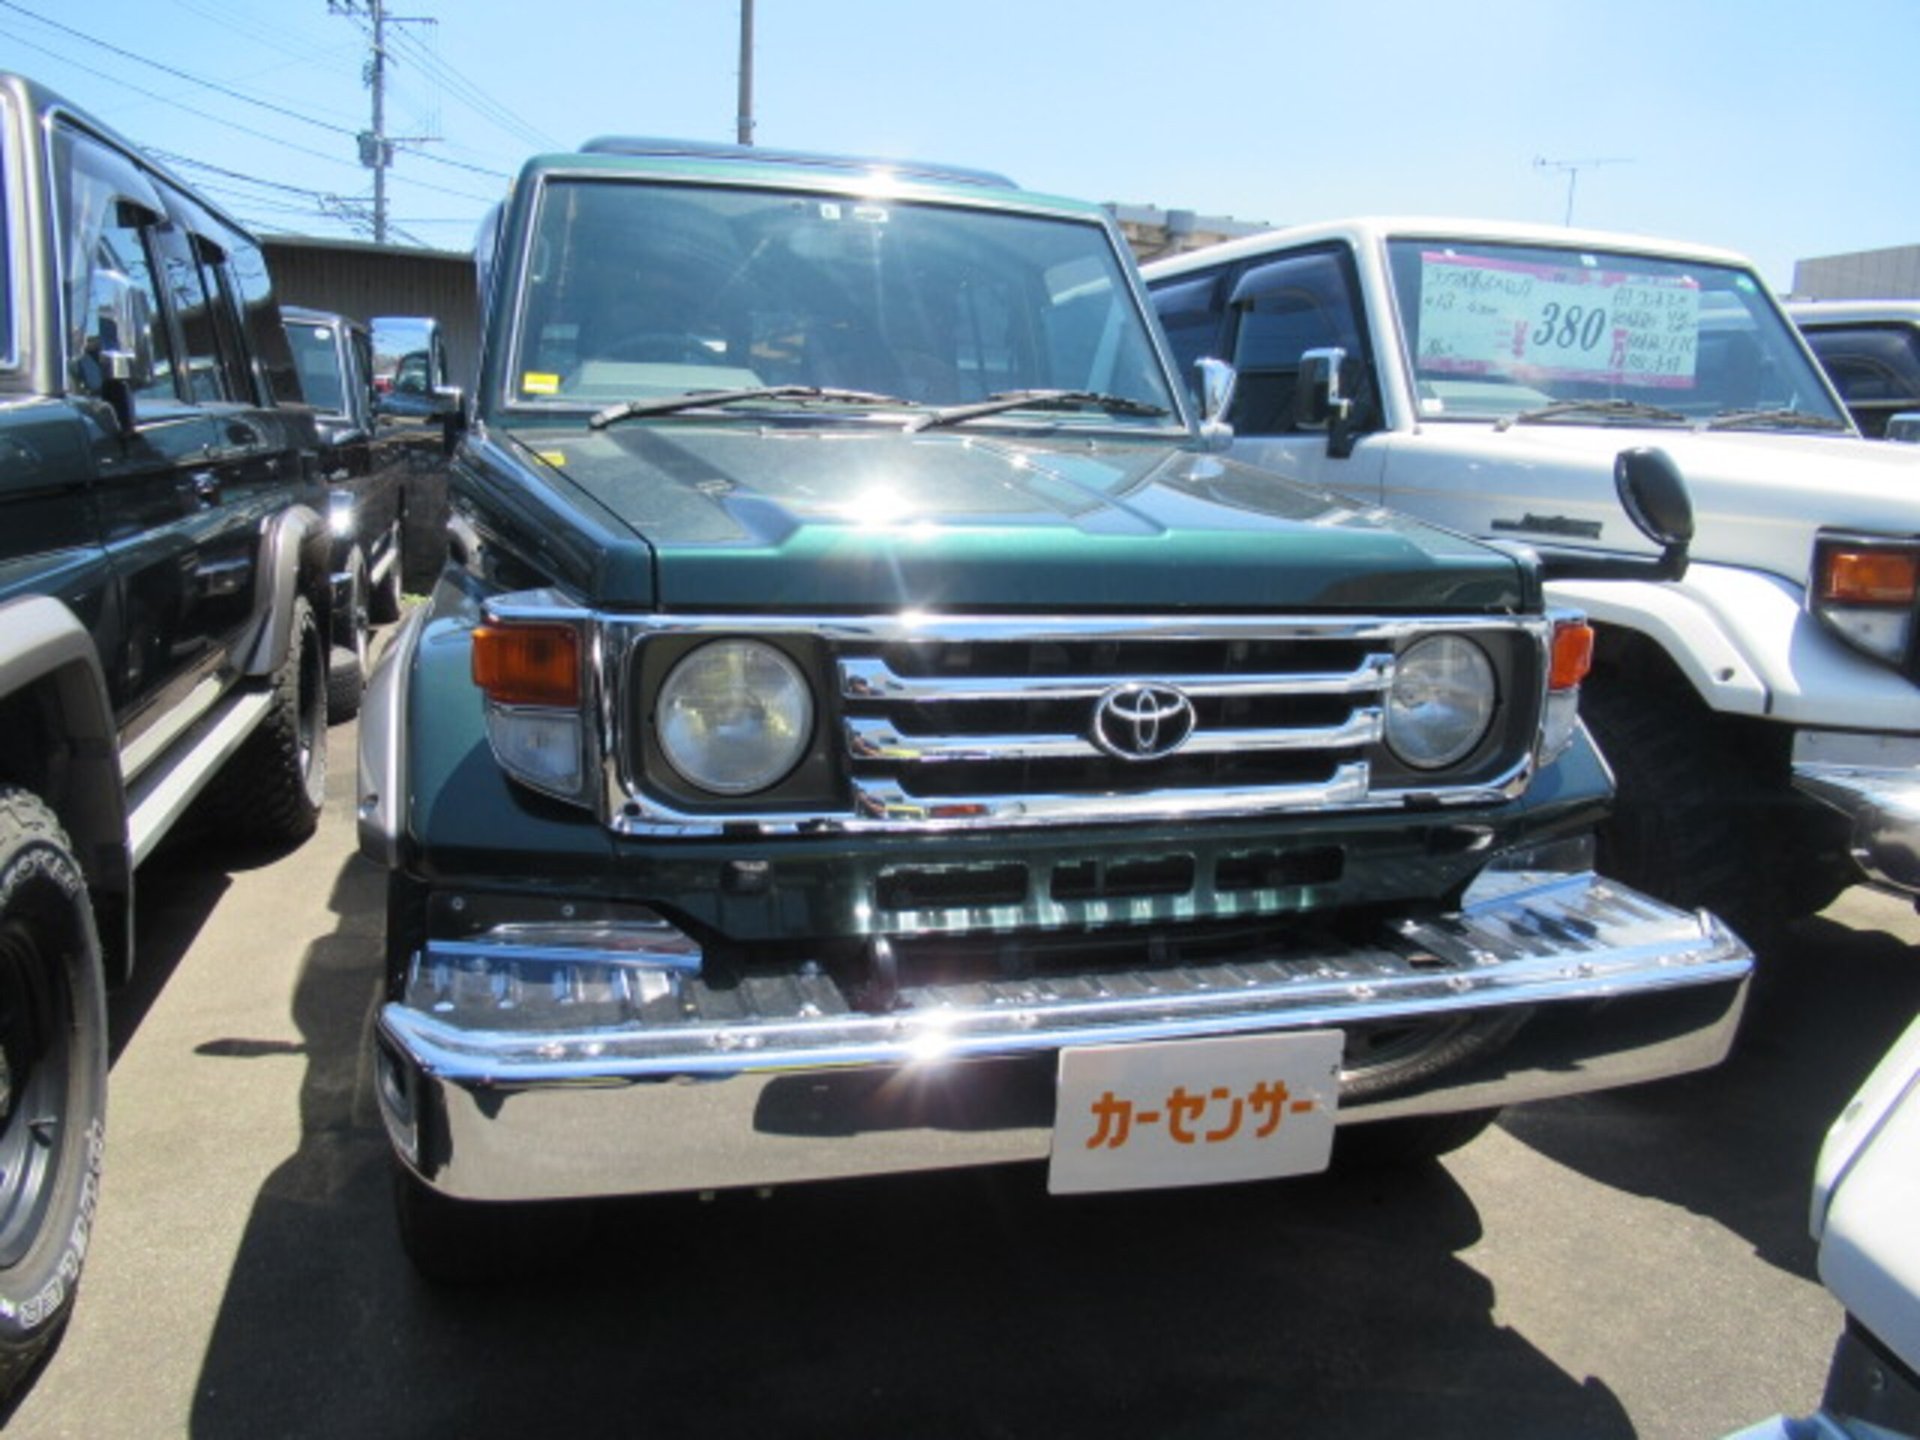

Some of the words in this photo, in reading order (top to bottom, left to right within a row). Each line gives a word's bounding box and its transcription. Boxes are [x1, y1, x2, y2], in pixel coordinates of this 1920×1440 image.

[1532, 302, 1606, 351] 380
[1086, 1080, 1314, 1150] カーセンサー
